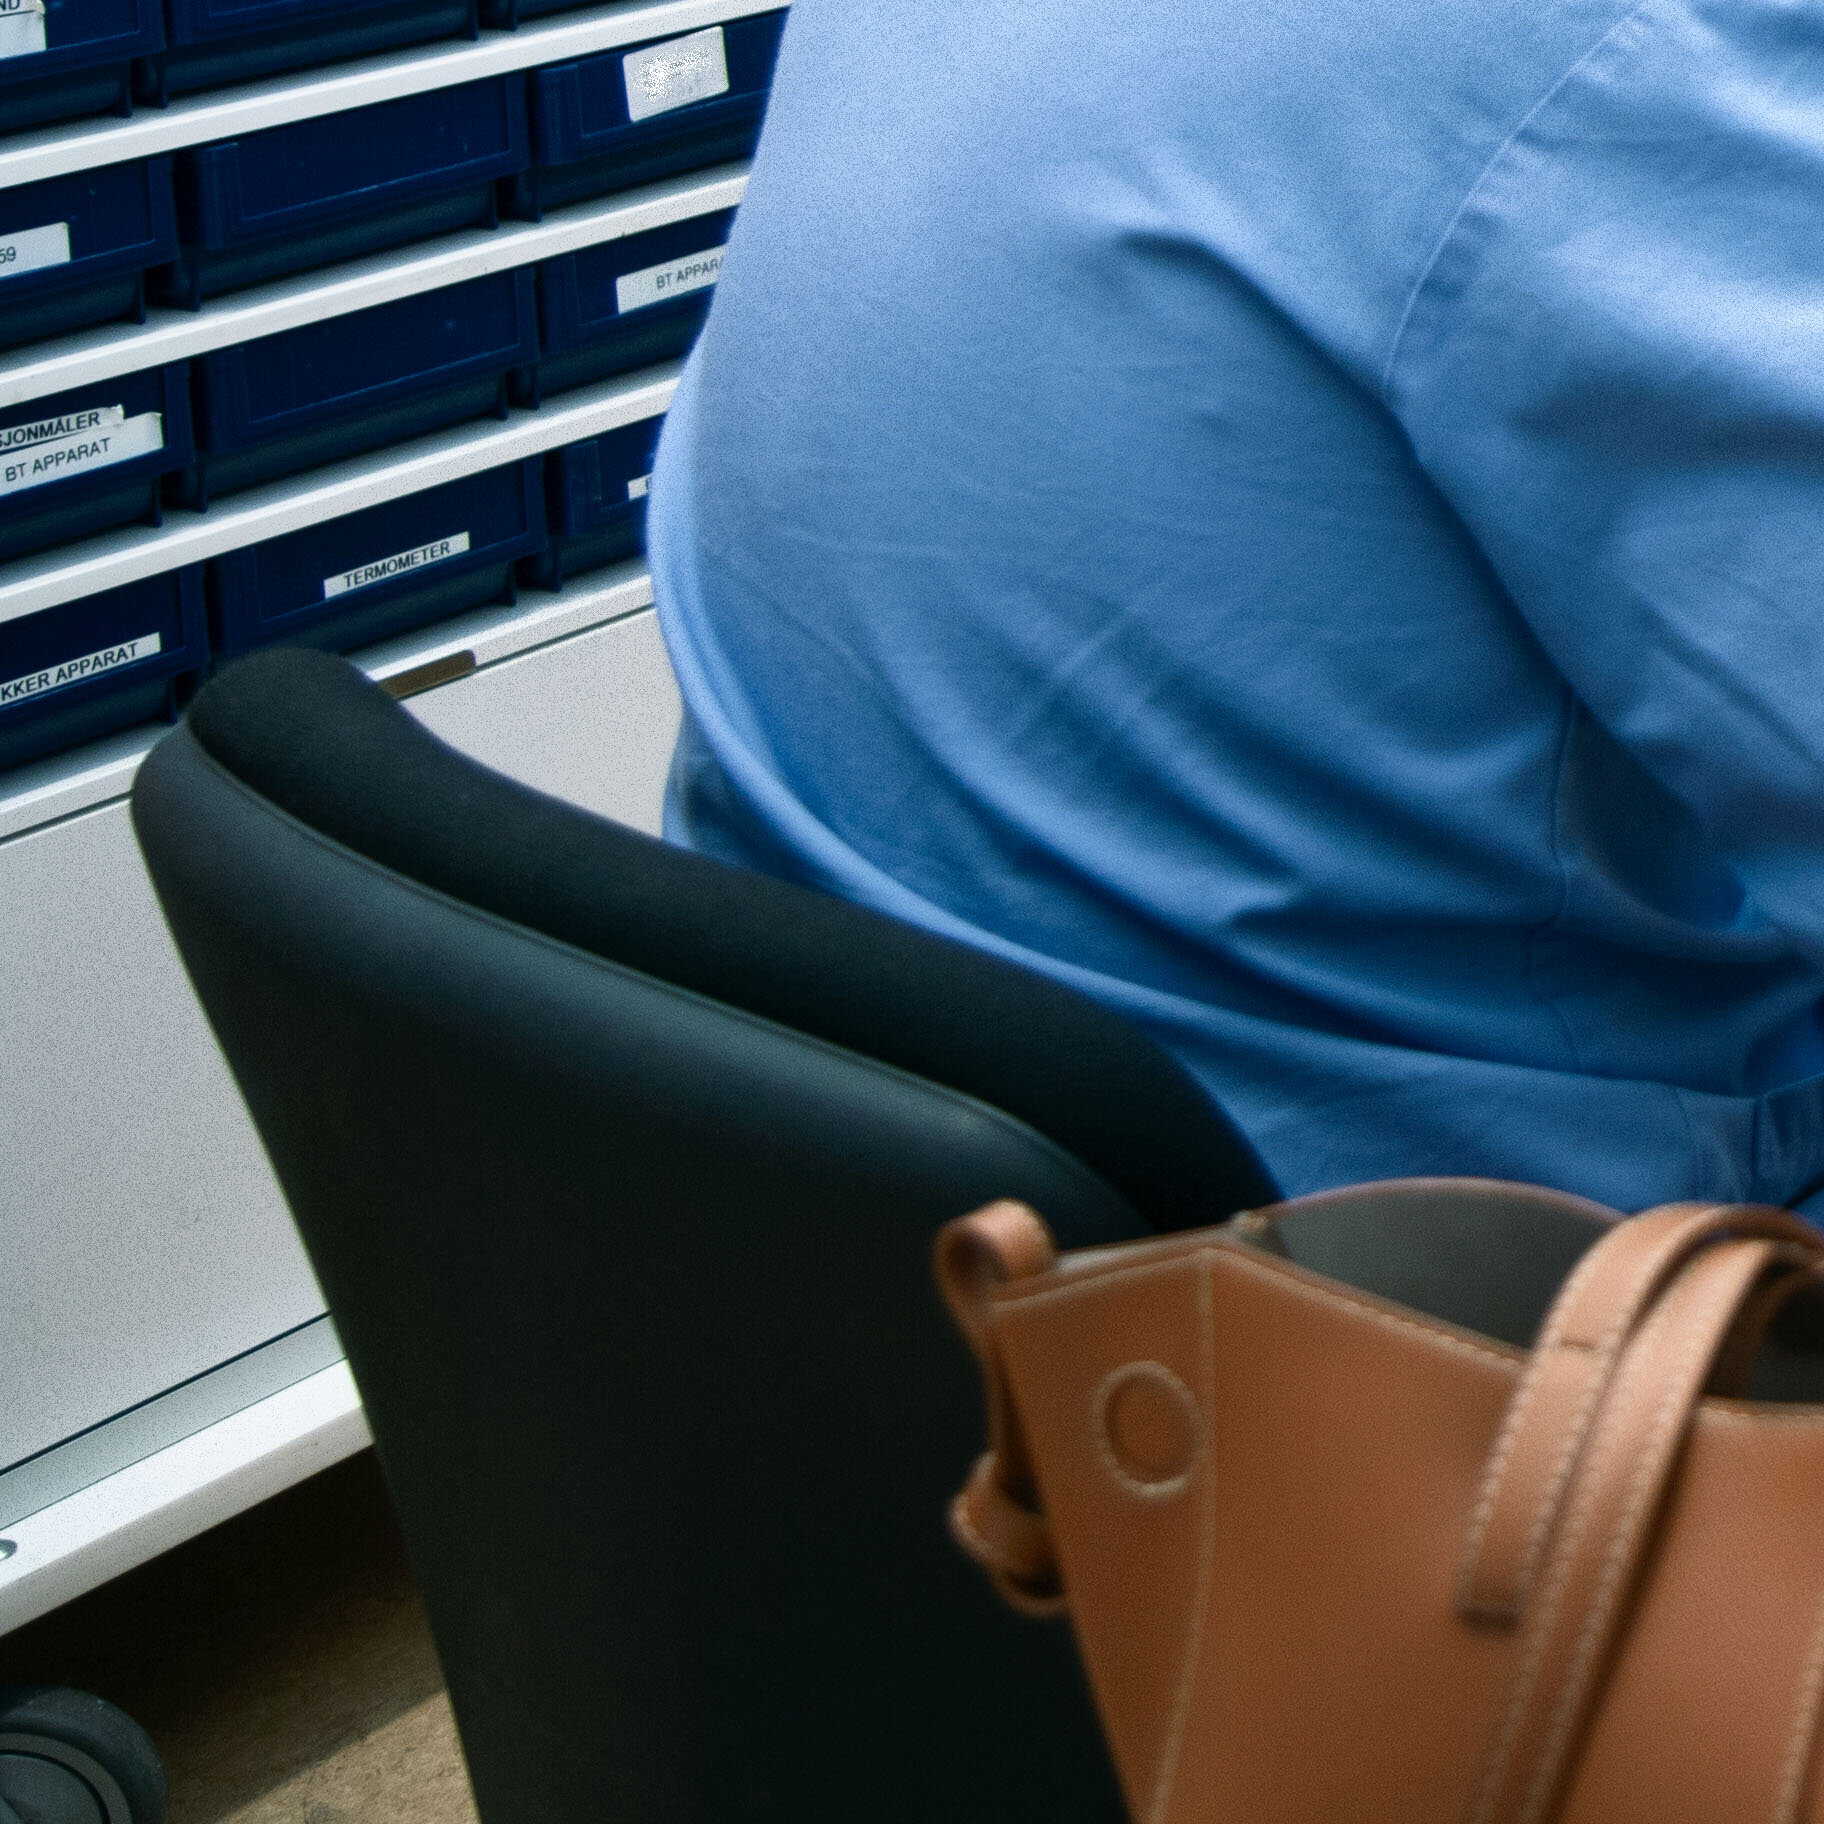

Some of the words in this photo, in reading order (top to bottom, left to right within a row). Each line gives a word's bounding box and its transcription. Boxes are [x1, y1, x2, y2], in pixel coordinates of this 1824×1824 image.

[656, 272, 673, 290] BT
[0, 410, 101, 448] JONMÅLER
[5, 461, 28, 483] BT
[32, 436, 112, 475] APPARAT
[343, 540, 452, 588] TERMOMETER
[54, 641, 140, 684] APPARAT
